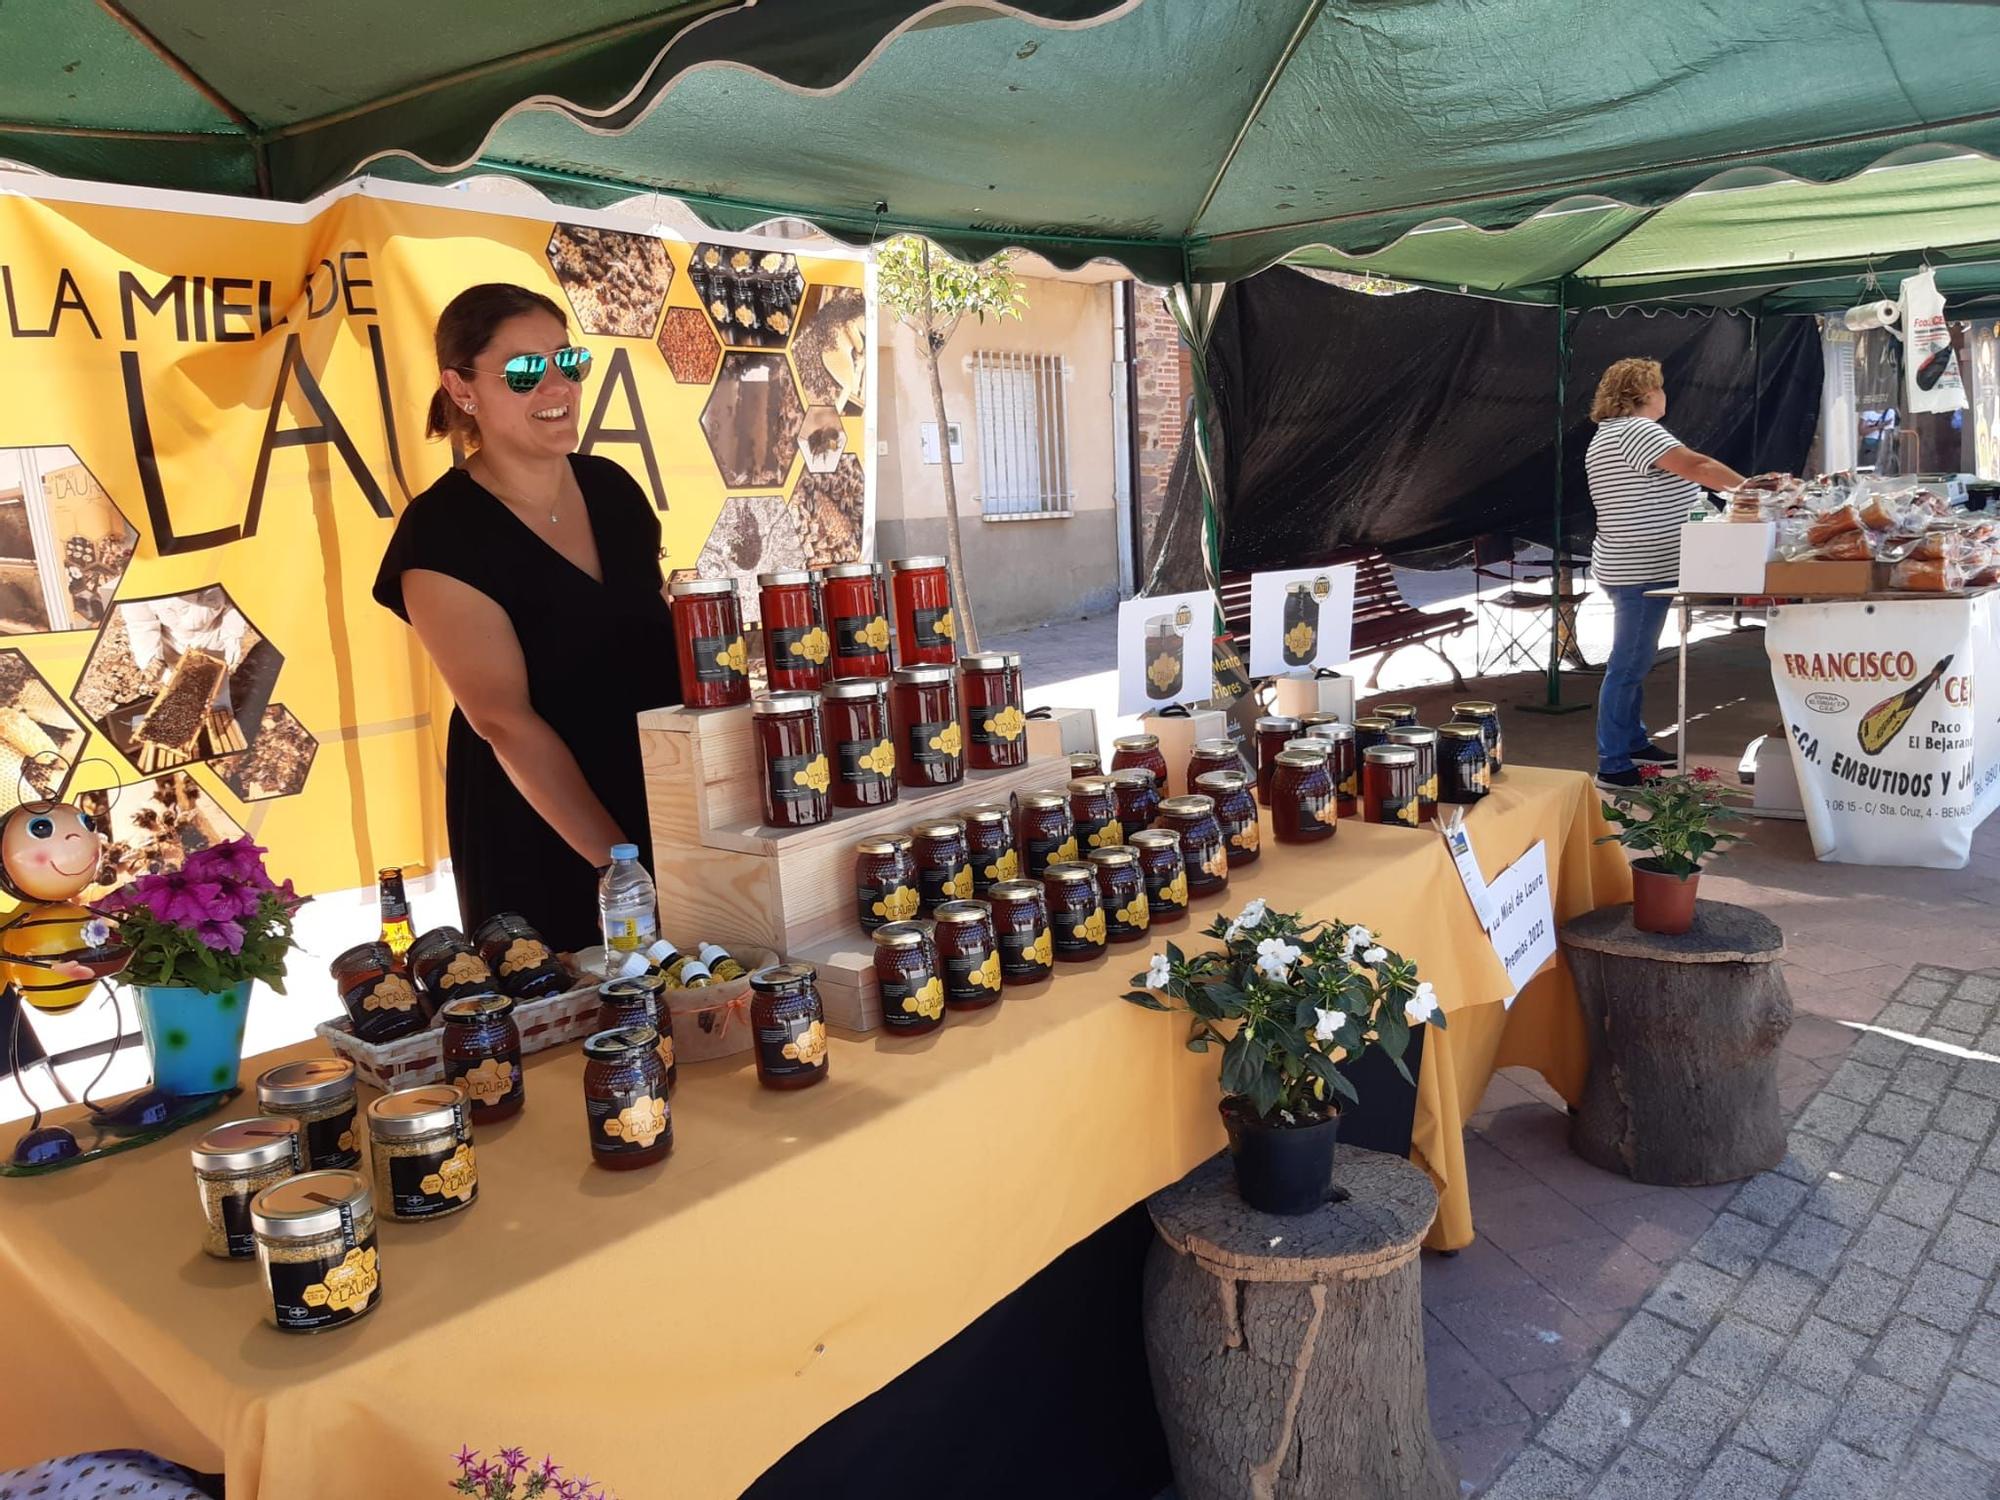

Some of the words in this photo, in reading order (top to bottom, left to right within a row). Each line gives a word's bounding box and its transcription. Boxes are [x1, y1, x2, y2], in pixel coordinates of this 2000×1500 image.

[1, 264, 103, 340] LA
[118, 270, 289, 343] MIEL
[303, 250, 378, 321] DE
[1783, 650, 1918, 682] FRANCISCO
[1943, 674, 1974, 707] CE
[1908, 736, 1920, 749] El
[1931, 720, 1961, 734] Paco
[1831, 751, 1934, 798] EMBUTIDOS
[1940, 770, 1951, 796] Y
[1957, 756, 1974, 791] JA
[1832, 800, 1844, 811] 06
[1847, 801, 1857, 812] 15
[1864, 802, 1878, 816] C/
[1879, 803, 1897, 816] Sta.
[1899, 804, 1923, 819] Cruz,
[1925, 807, 1932, 818] 4
[1500, 893, 1515, 921] Miel
[1515, 888, 1524, 908] de
[1524, 873, 1543, 899] Laura
[1504, 938, 1528, 971] Premios
[1527, 918, 1545, 947] 2022
[631, 1120, 664, 1137] LAURA
[338, 1273, 377, 1303] LAURA
